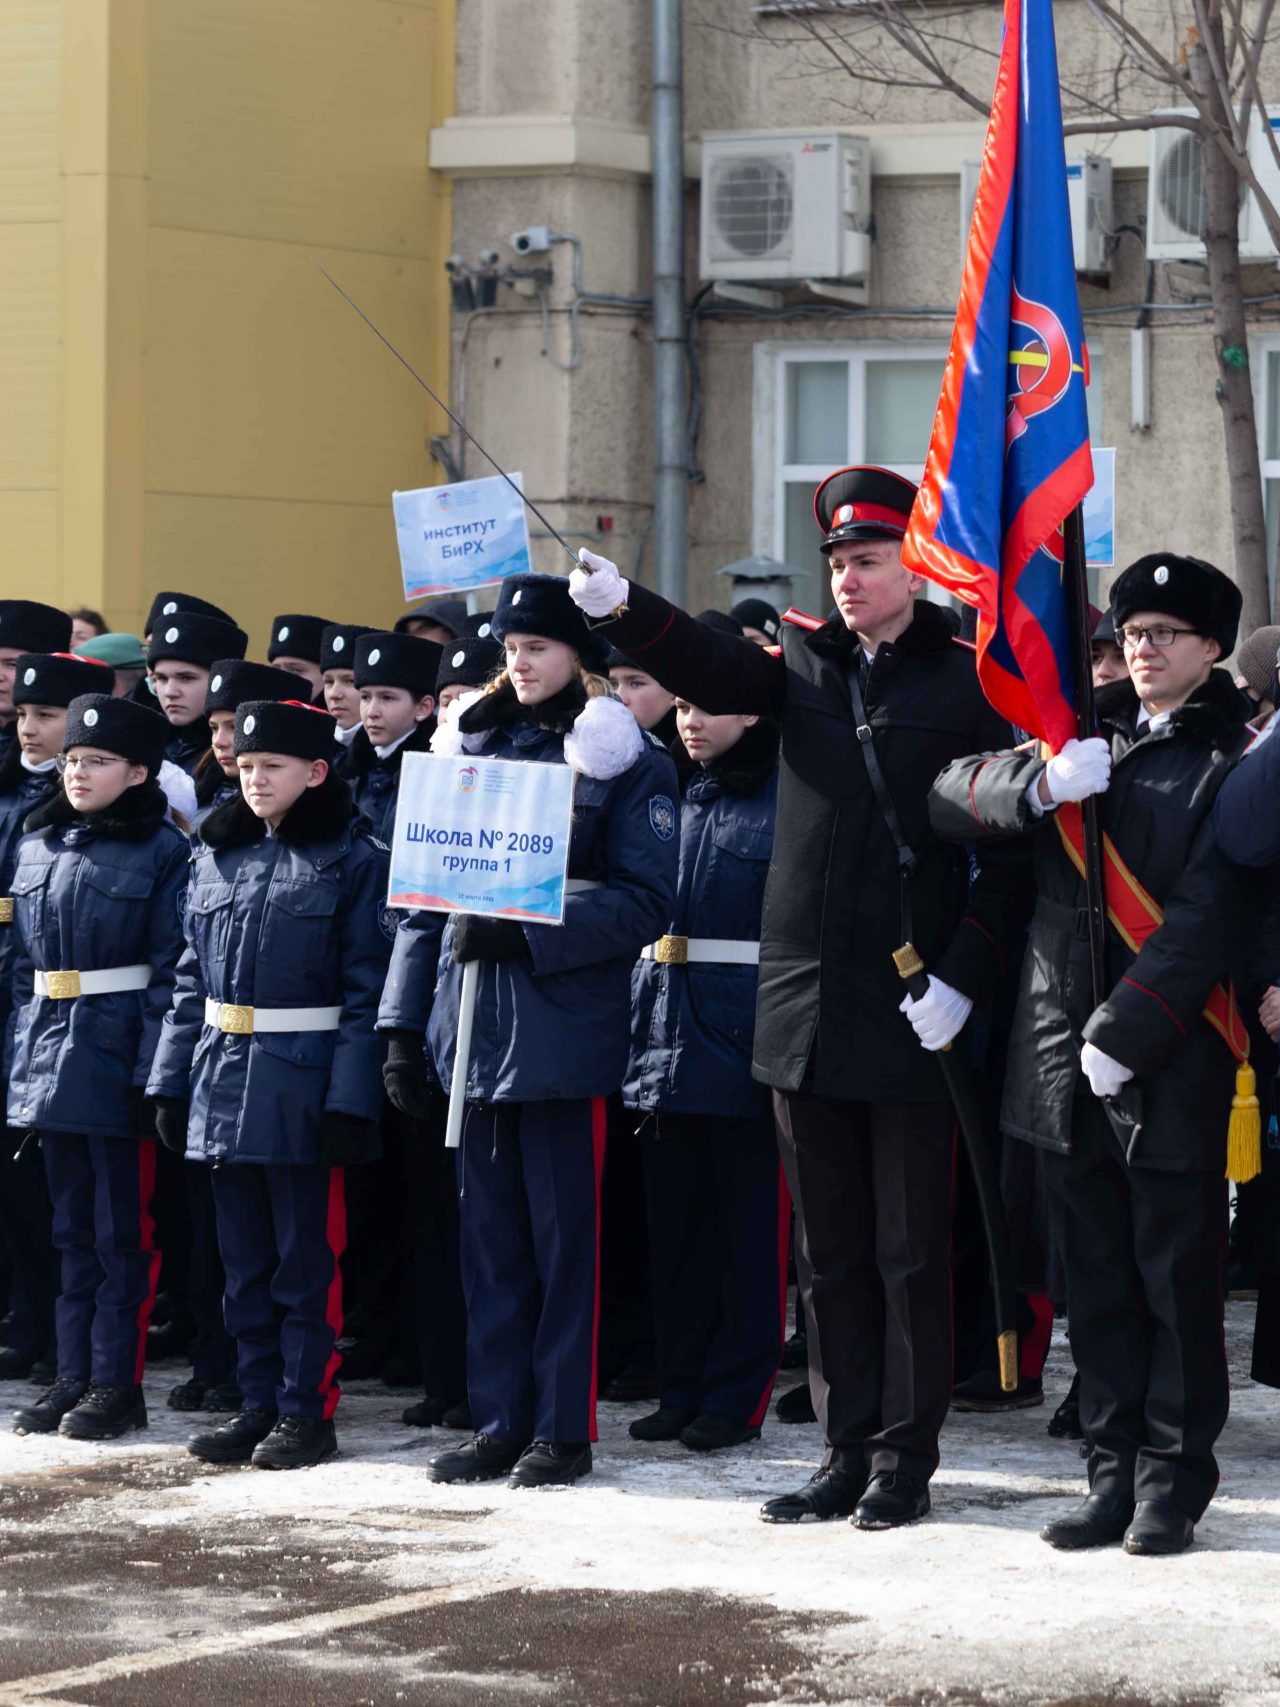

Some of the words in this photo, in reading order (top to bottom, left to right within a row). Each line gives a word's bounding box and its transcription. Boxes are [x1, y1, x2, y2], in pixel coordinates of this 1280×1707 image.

[424, 519, 496, 540] институт
[441, 540, 485, 559] БиРХ
[406, 822, 473, 848] Школа
[507, 832, 554, 855] 2089
[443, 855, 498, 872] группа
[504, 858, 511, 873] 1
